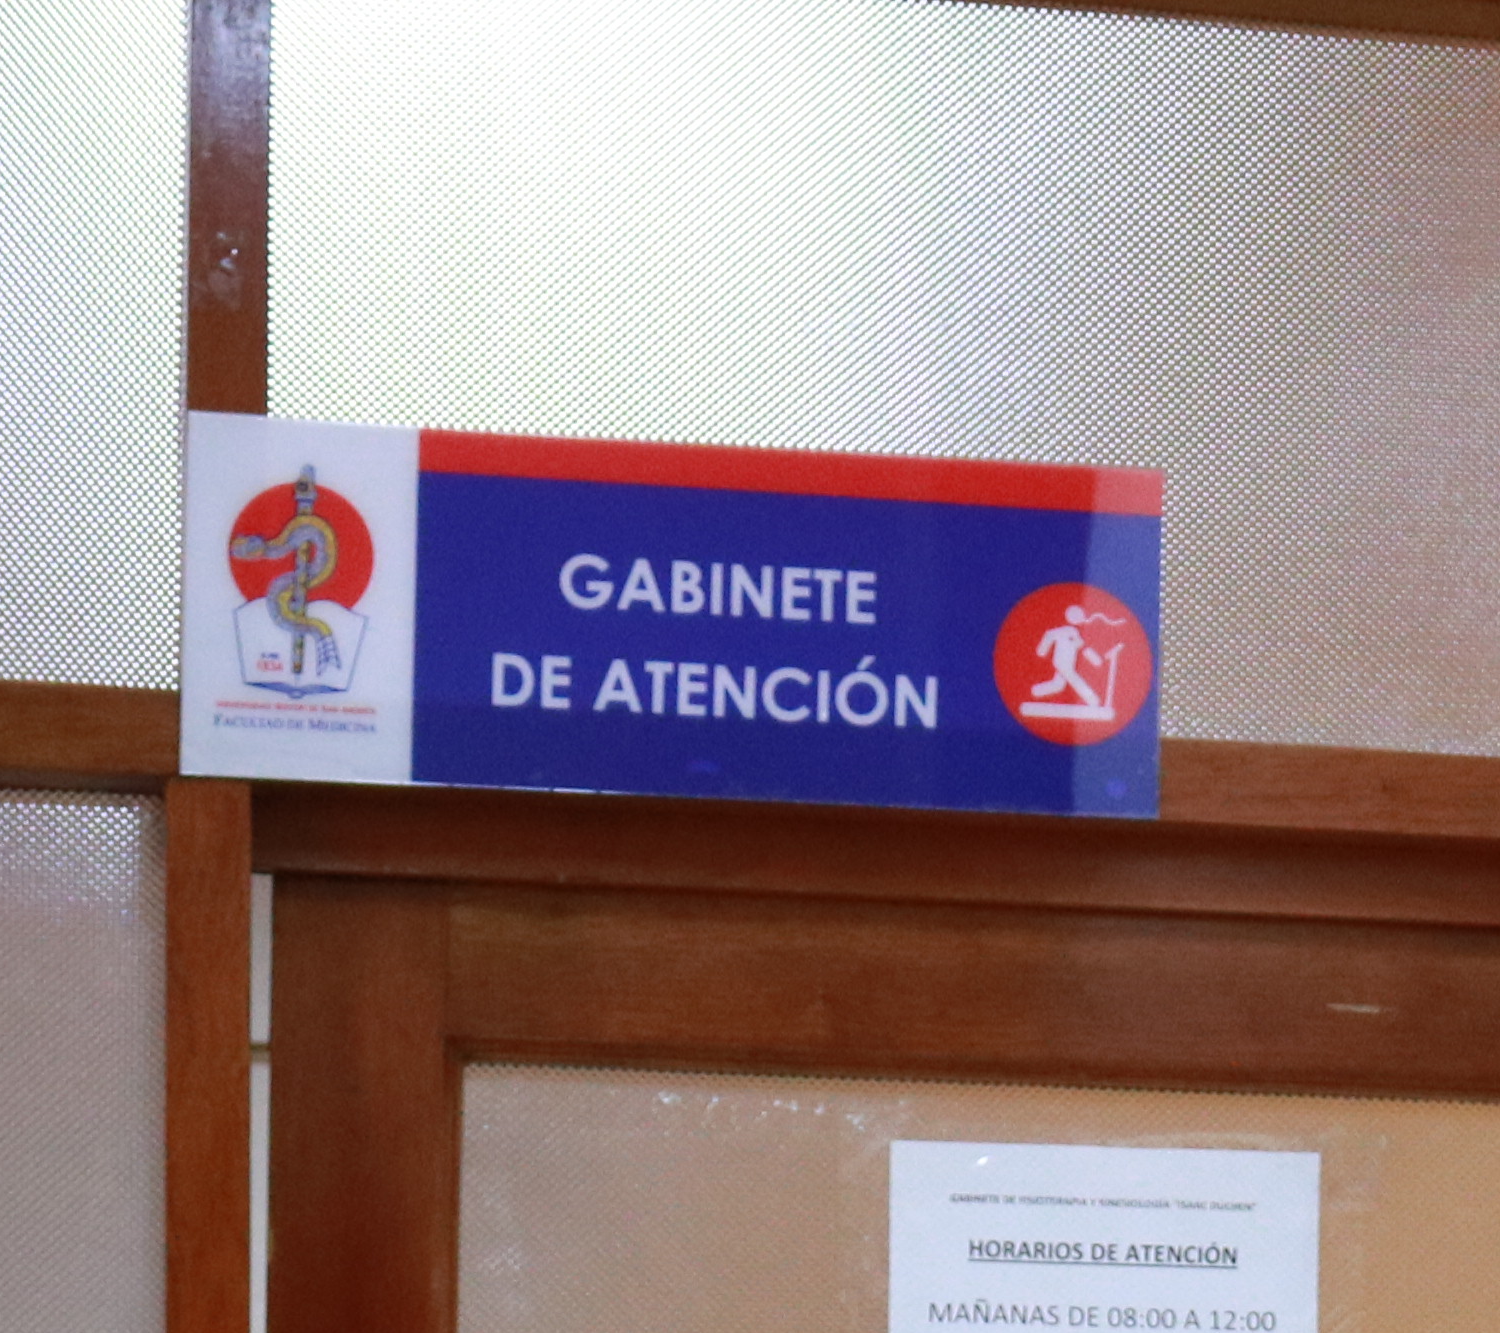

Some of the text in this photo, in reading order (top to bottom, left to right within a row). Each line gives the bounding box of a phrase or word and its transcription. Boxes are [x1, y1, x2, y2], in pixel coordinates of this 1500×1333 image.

[560, 554, 876, 624] GABINETE
[492, 653, 937, 728] DE ATENCIÓN
[969, 1240, 1237, 1266] HORARIOS DE ATENCIÓN
[929, 1299, 1277, 1332] MAÑANAS DE 08:00 A 12:00
